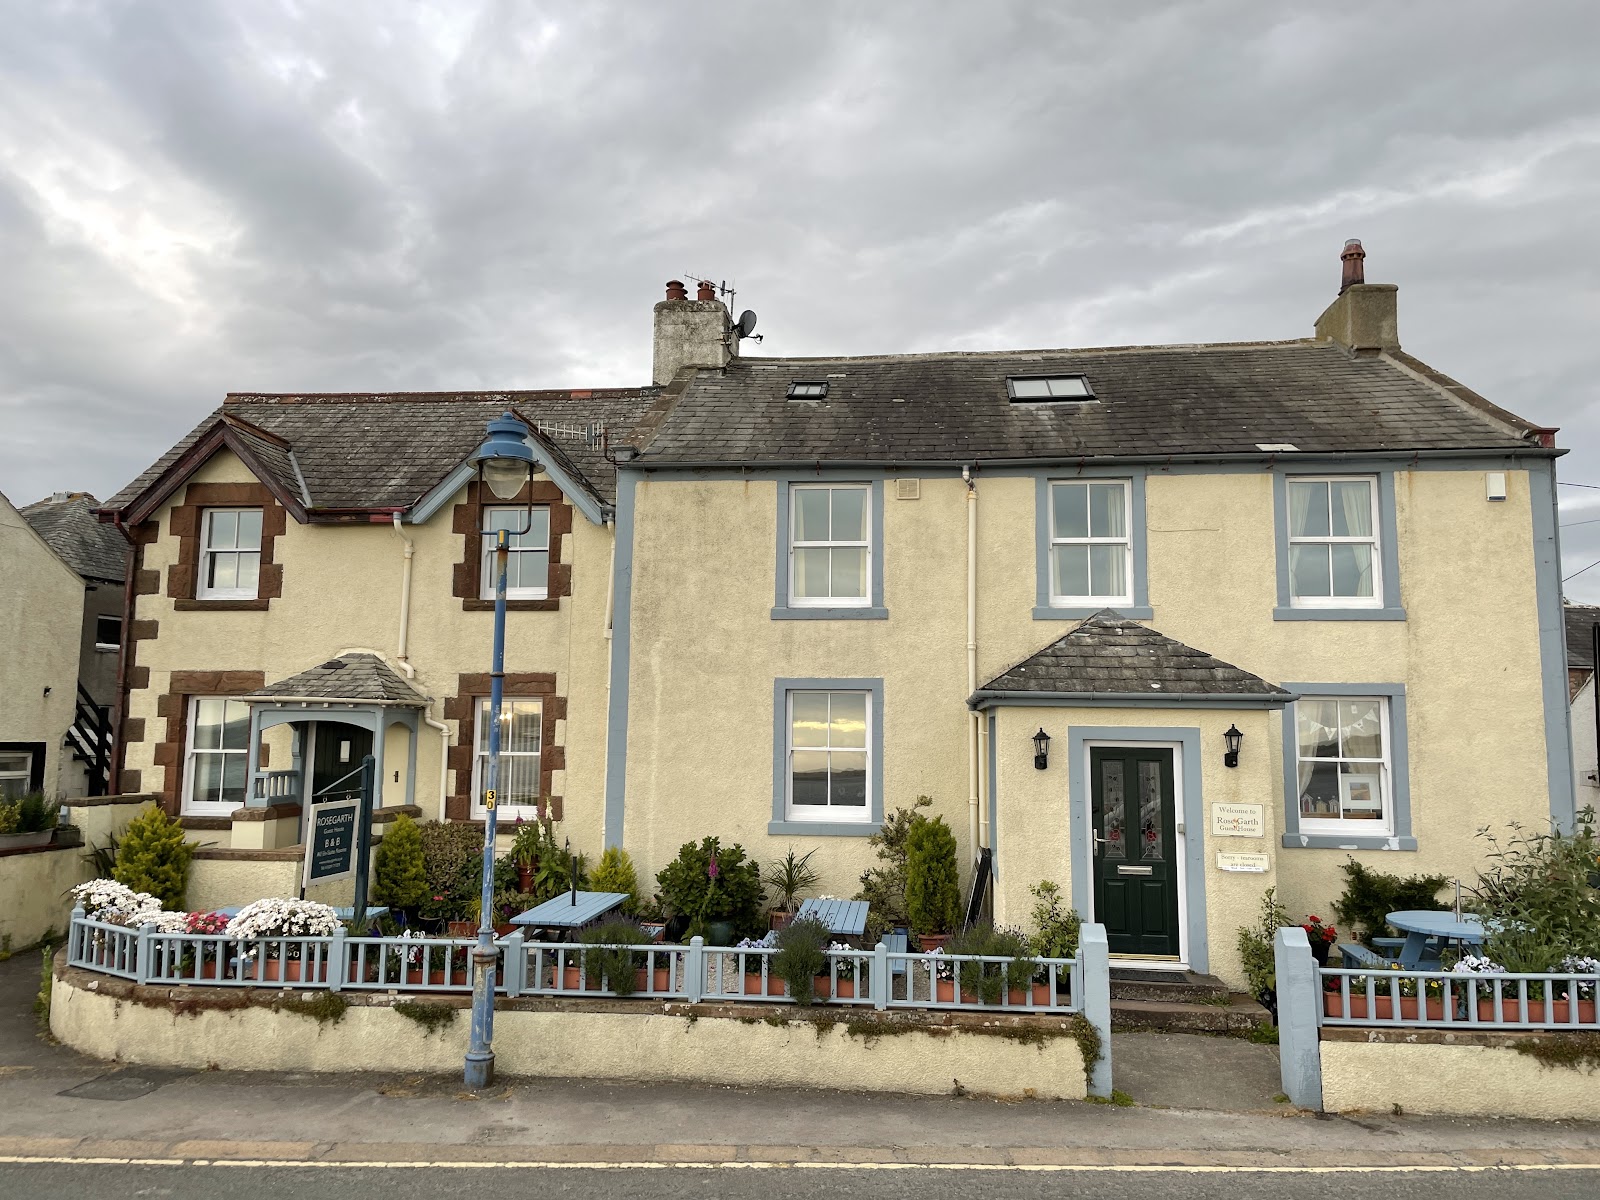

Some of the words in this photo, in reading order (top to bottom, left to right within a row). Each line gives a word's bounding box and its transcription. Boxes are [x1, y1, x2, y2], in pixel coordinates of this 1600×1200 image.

[317, 813, 353, 826] ROSEGARTH
[325, 839, 330, 848] B
[330, 838, 335, 847] &
[336, 837, 341, 846] B
